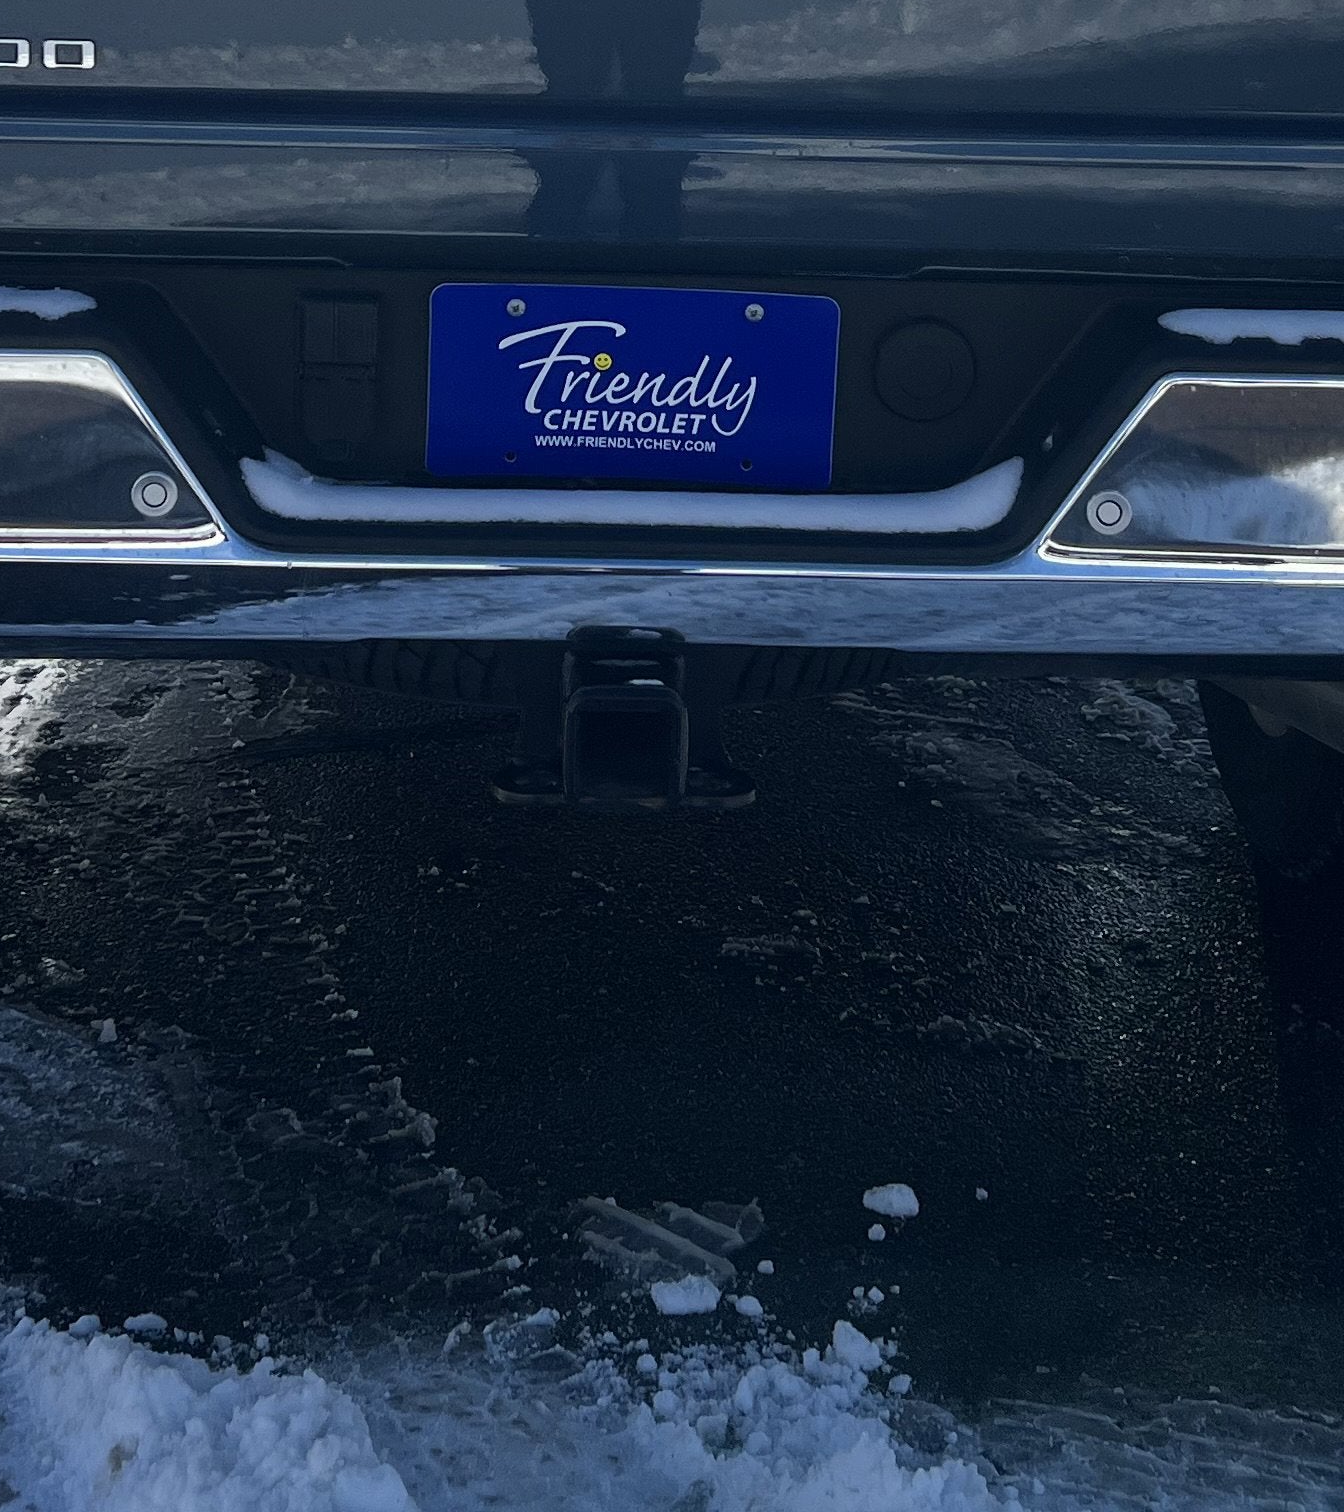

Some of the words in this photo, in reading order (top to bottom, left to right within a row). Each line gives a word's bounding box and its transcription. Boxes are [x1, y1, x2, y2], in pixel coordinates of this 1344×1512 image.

[499, 320, 757, 437] Friendly
[543, 409, 706, 435] CHEVROLET
[534, 434, 716, 453] WWW.FRIENDLYCHEV.COM
